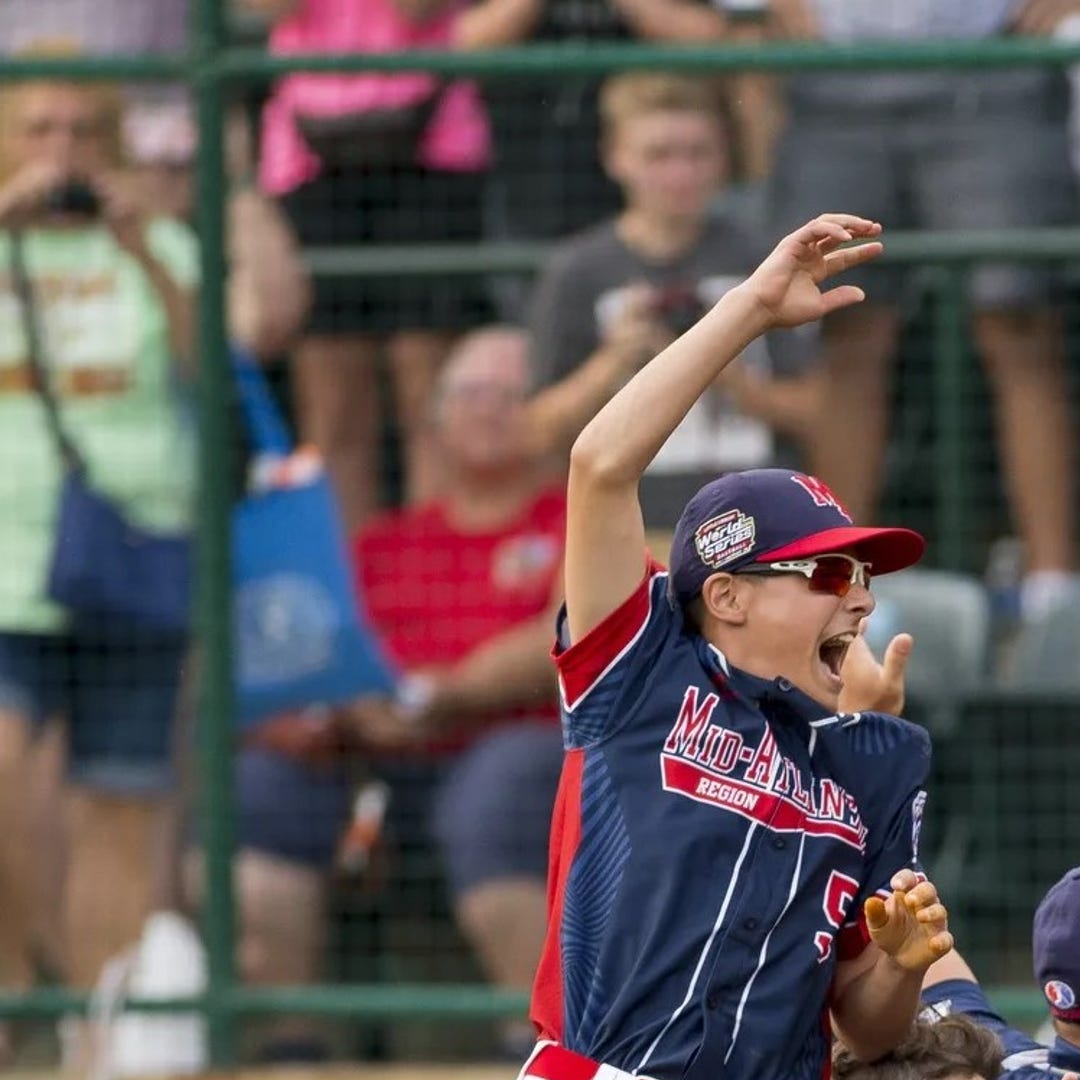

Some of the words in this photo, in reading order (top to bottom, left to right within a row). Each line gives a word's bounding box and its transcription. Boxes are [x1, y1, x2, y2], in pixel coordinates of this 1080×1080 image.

[698, 518, 745, 550] World
[704, 527, 753, 559] Series
[696, 777, 759, 811] REGION
